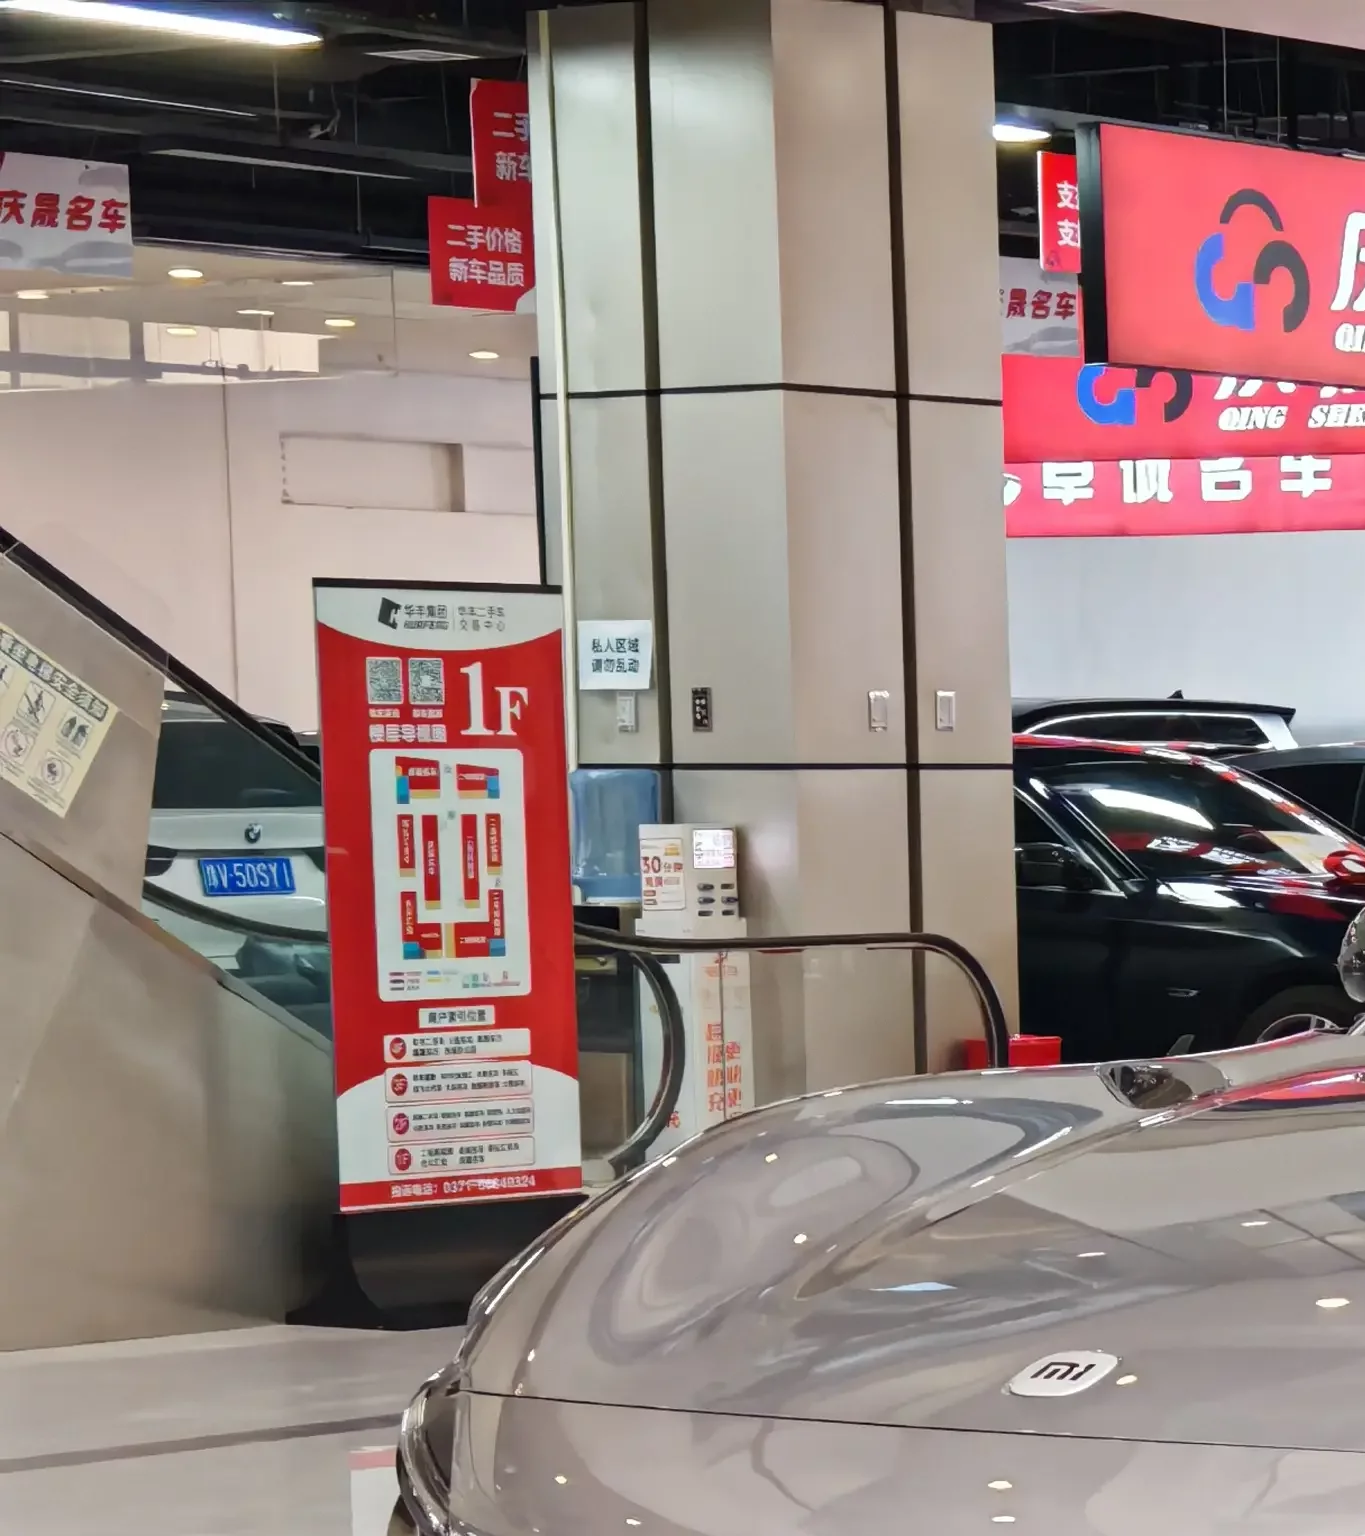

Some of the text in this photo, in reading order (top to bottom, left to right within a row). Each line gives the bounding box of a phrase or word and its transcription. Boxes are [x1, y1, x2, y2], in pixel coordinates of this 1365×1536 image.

[446, 224, 523, 253] 二手价格
[448, 256, 525, 287] 新车品质
[1000, 287, 1077, 320] 晟名车
[1218, 404, 1289, 431] QING
[591, 637, 639, 653] 私人区域
[591, 658, 640, 673] 请勿乱动
[460, 661, 529, 736] 1F
